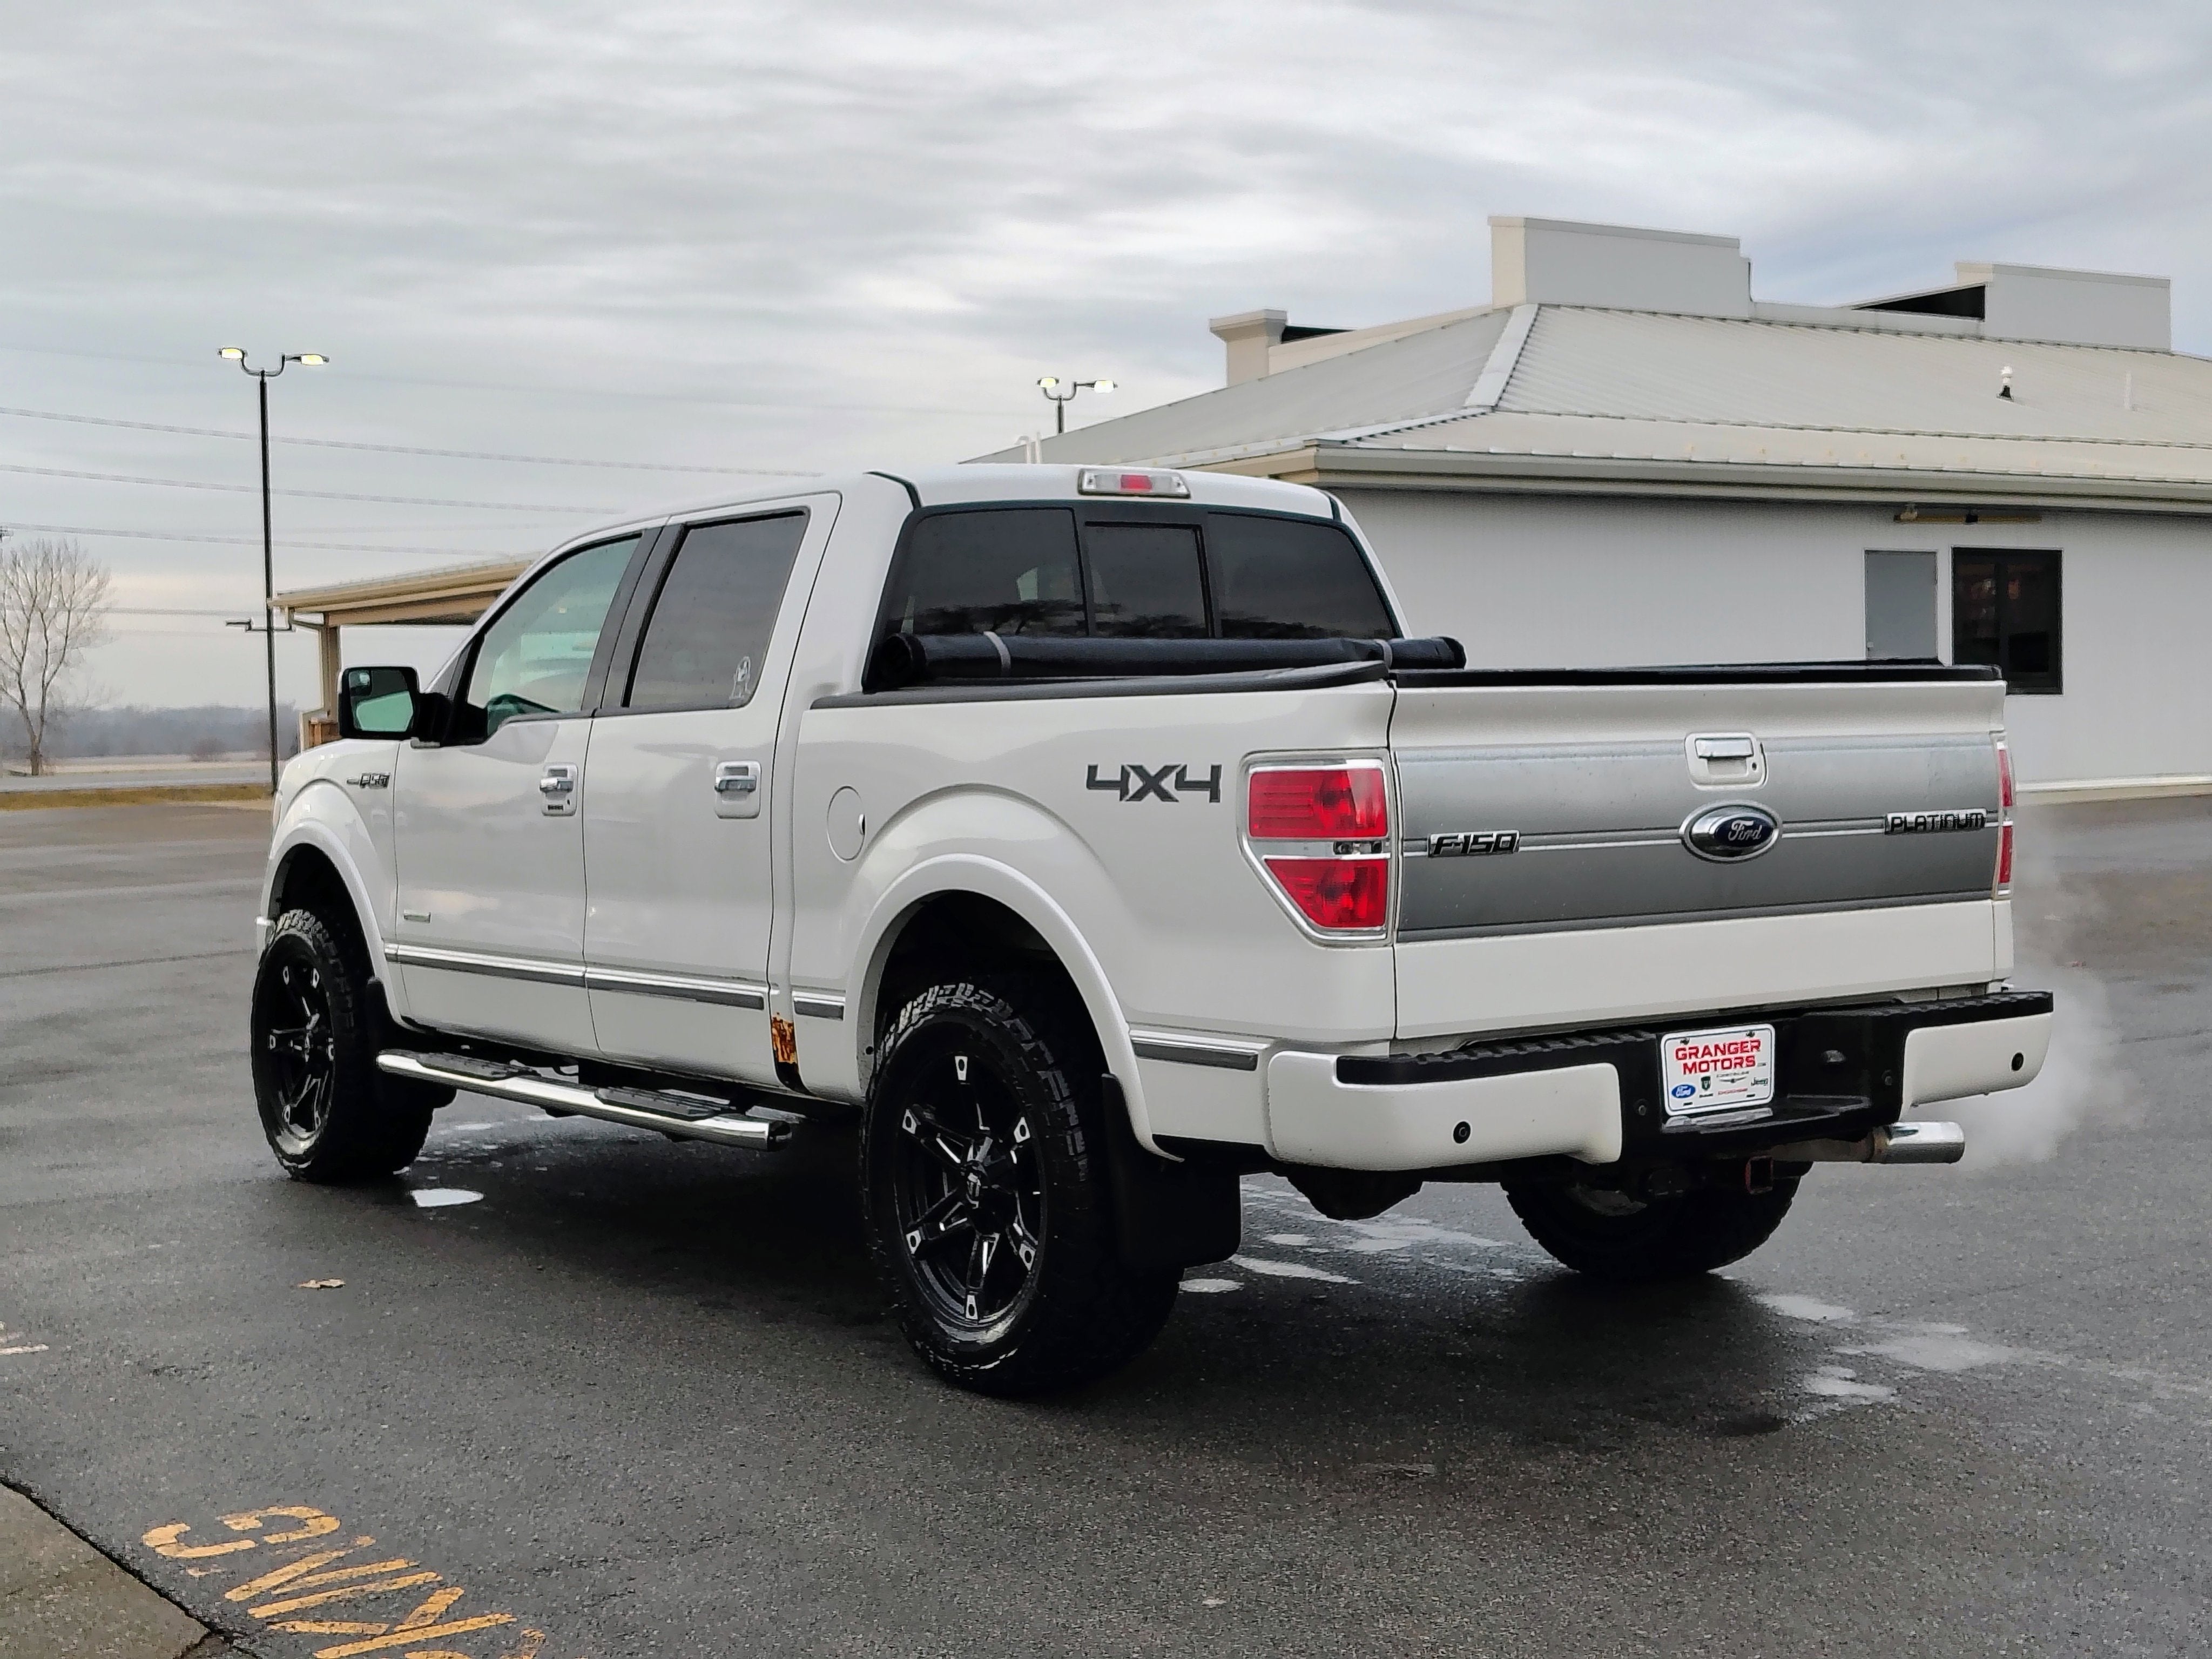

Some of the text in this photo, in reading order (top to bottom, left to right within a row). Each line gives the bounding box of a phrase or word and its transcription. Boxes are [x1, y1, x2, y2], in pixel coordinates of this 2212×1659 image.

[1728, 819, 1763, 841] Ford
[1891, 812, 1986, 832] PLATINUM
[1675, 1039, 1762, 1061] GRANGER
[1683, 1055, 1756, 1075] MOTORS
